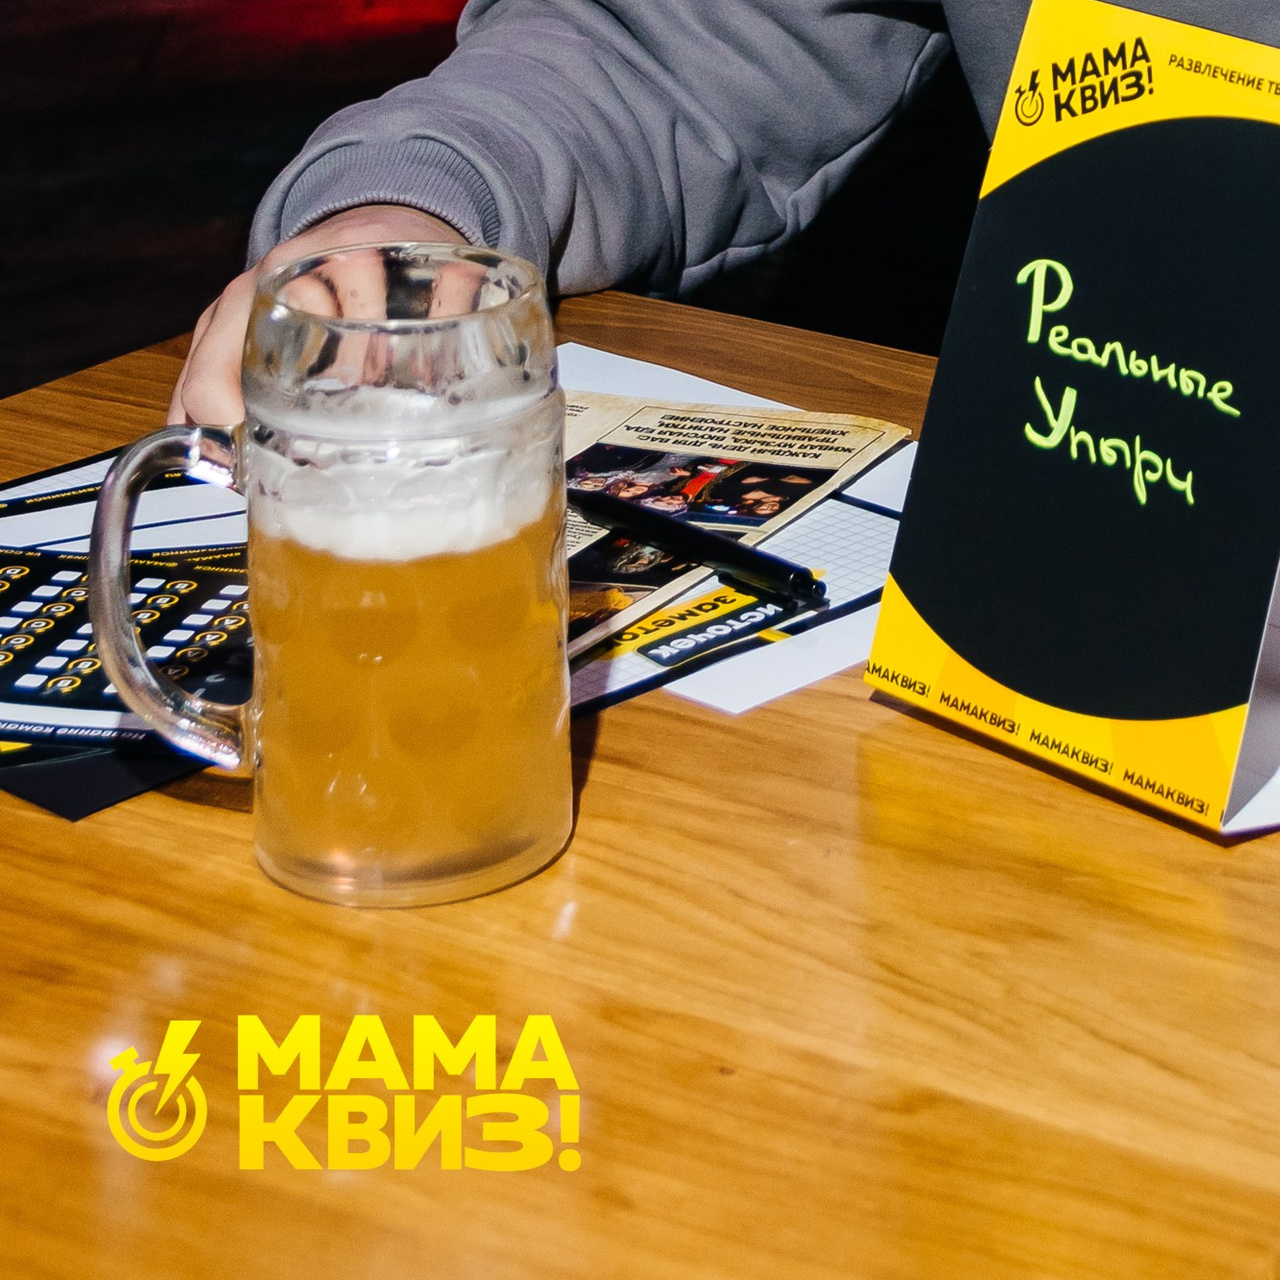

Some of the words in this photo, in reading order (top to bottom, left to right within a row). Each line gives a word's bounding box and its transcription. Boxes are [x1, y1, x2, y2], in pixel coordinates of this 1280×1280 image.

[1051, 36, 1151, 90] МАМА
[1168, 53, 1265, 91] РАЗВЛЕЧЕНИЕ
[1054, 66, 1155, 123] КВИЗ!
[1016, 258, 1241, 418] Реальные
[657, 430, 728, 442] ВКУСНАЯ
[671, 439, 707, 448] ДЛЯ
[731, 430, 839, 444] ПРАВИЛЬНЫЕ
[764, 424, 851, 437] ХМЕЛЬНОЕ
[708, 442, 752, 453] ДЕНЬ
[751, 448, 822, 460] КАЖДЫЙ
[798, 444, 857, 454] ЖИВАЯ
[608, 595, 737, 647] замето
[648, 603, 784, 659] источек
[939, 691, 1022, 736] МАМАКВИЗ!
[1029, 728, 1113, 775] МАМАКВИЗ!
[1122, 768, 1210, 817] МАМАКВИЗ!
